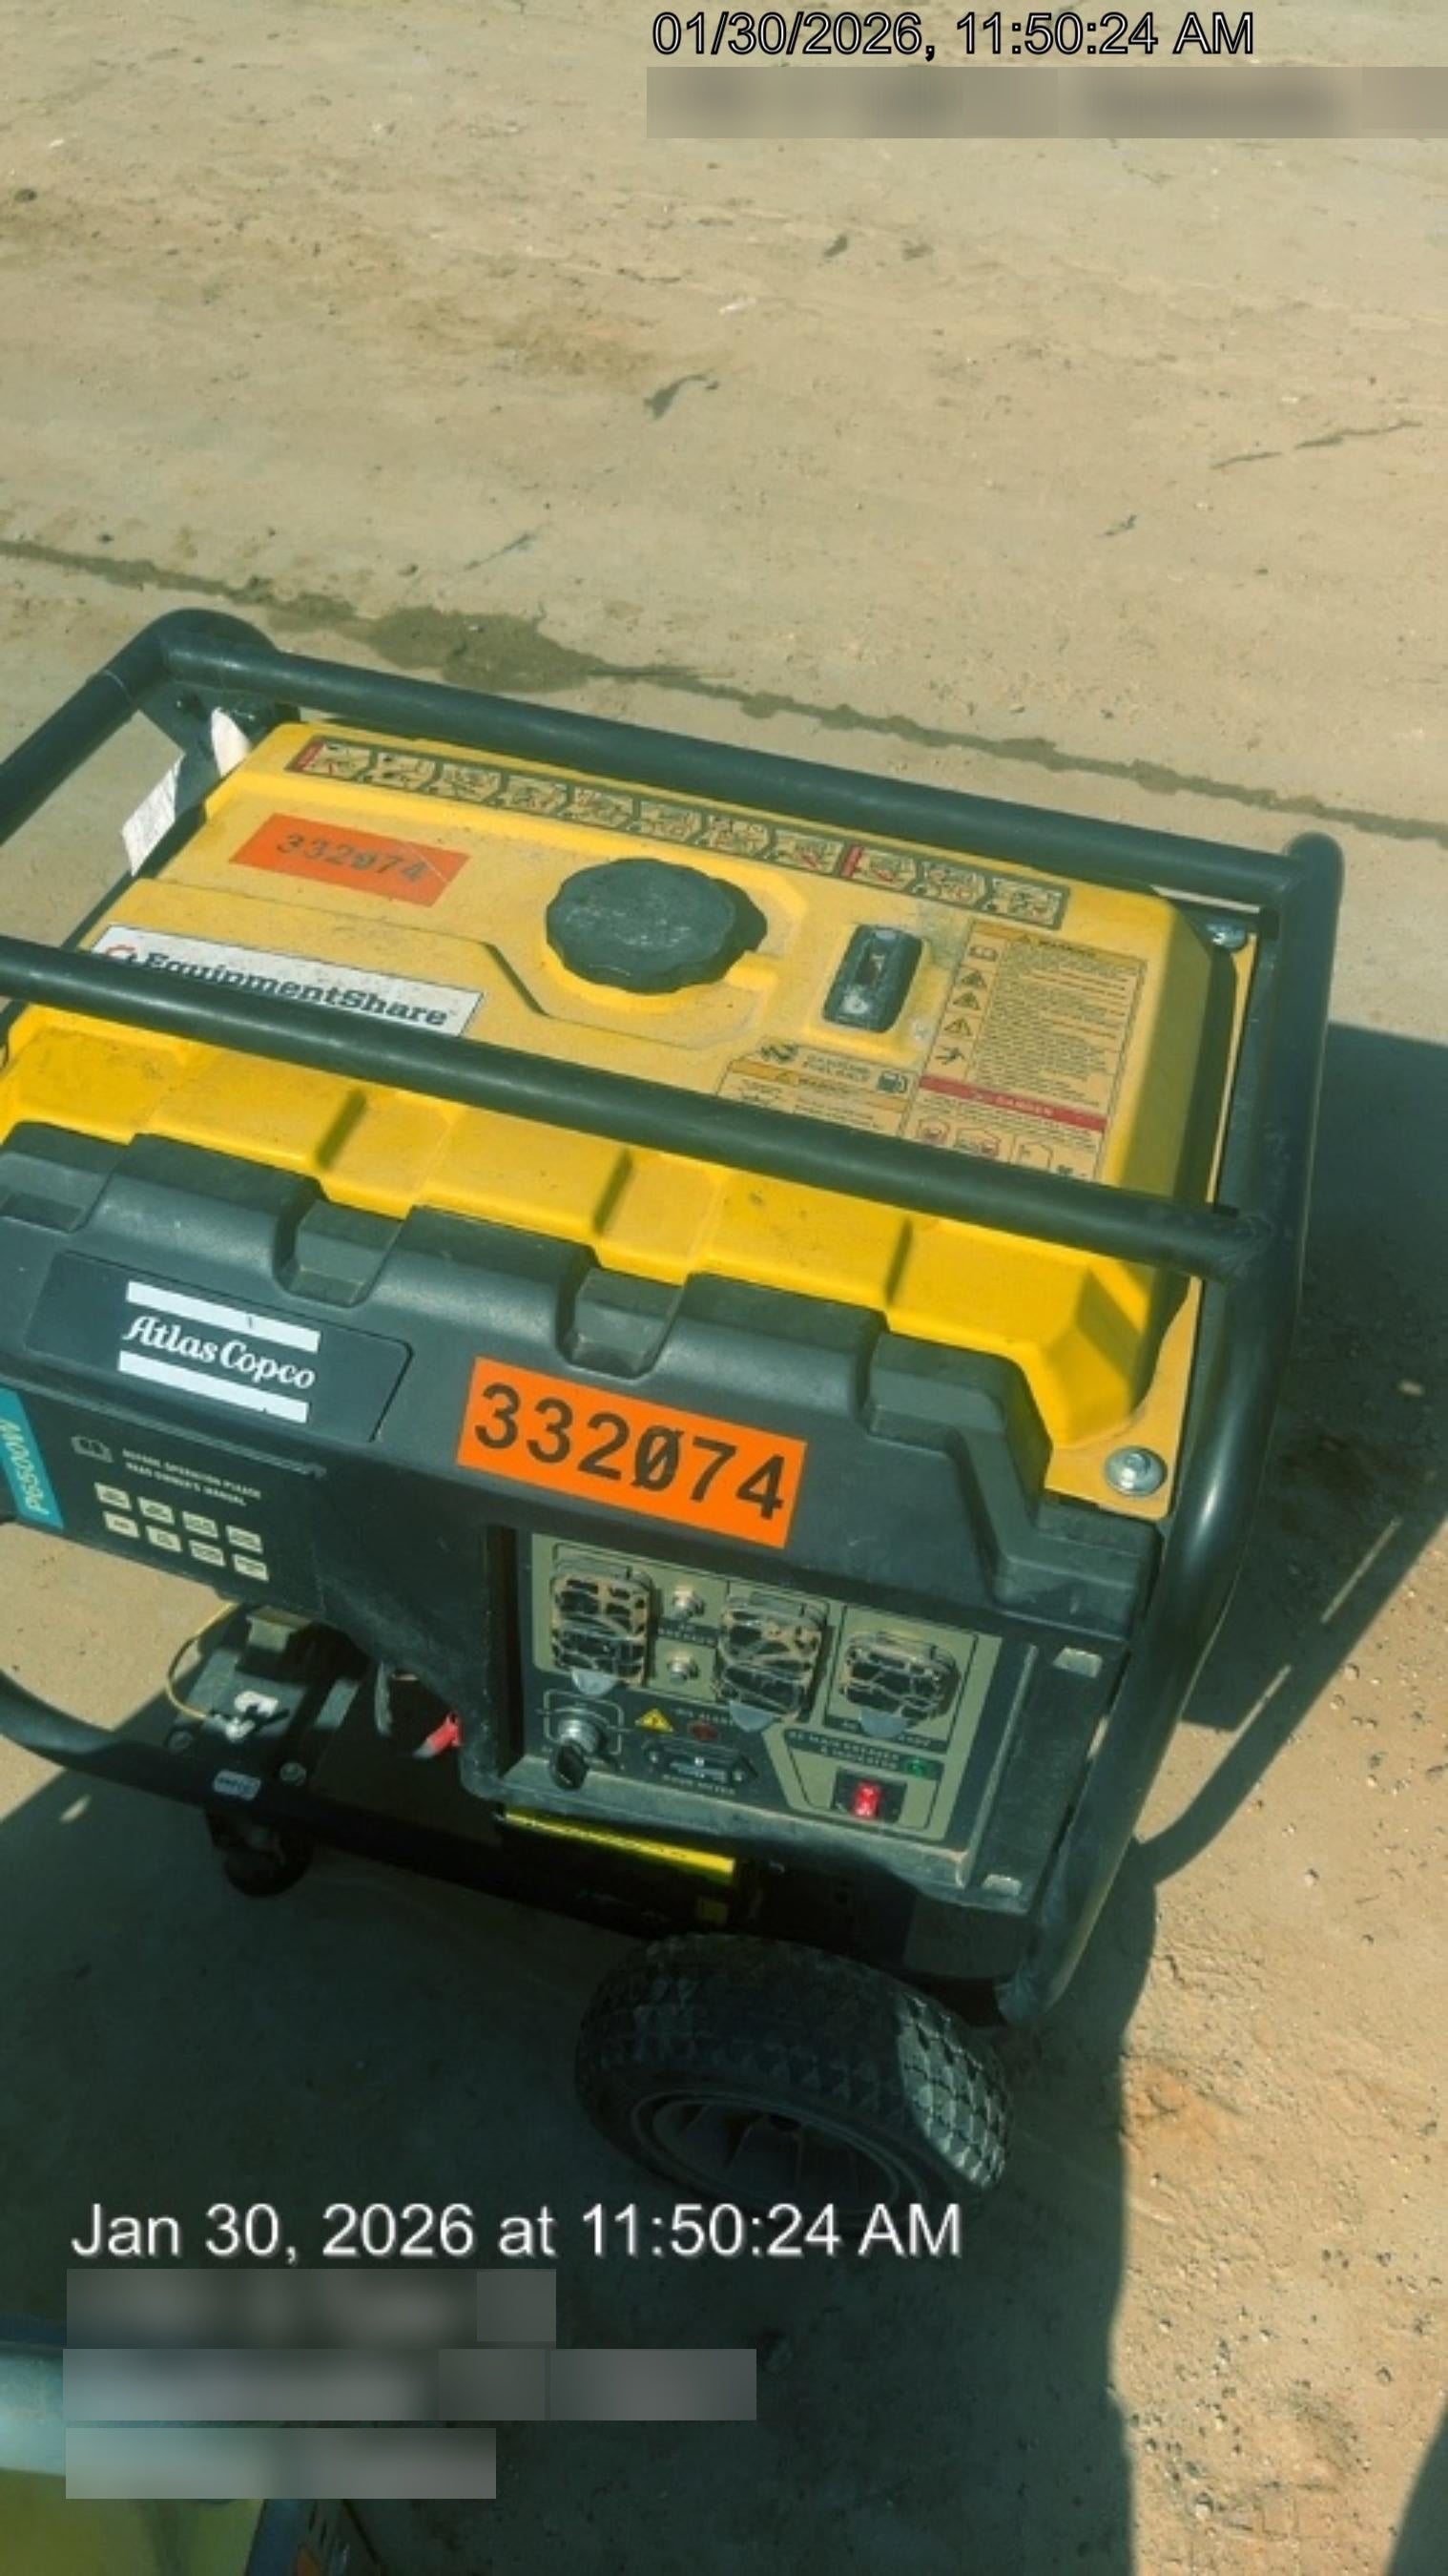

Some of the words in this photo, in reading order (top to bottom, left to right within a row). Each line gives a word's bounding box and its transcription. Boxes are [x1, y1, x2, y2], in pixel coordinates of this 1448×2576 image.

[122, 1315, 218, 1363] Atlas
[219, 1339, 316, 1389] Copco
[474, 1382, 786, 1521] 332074
